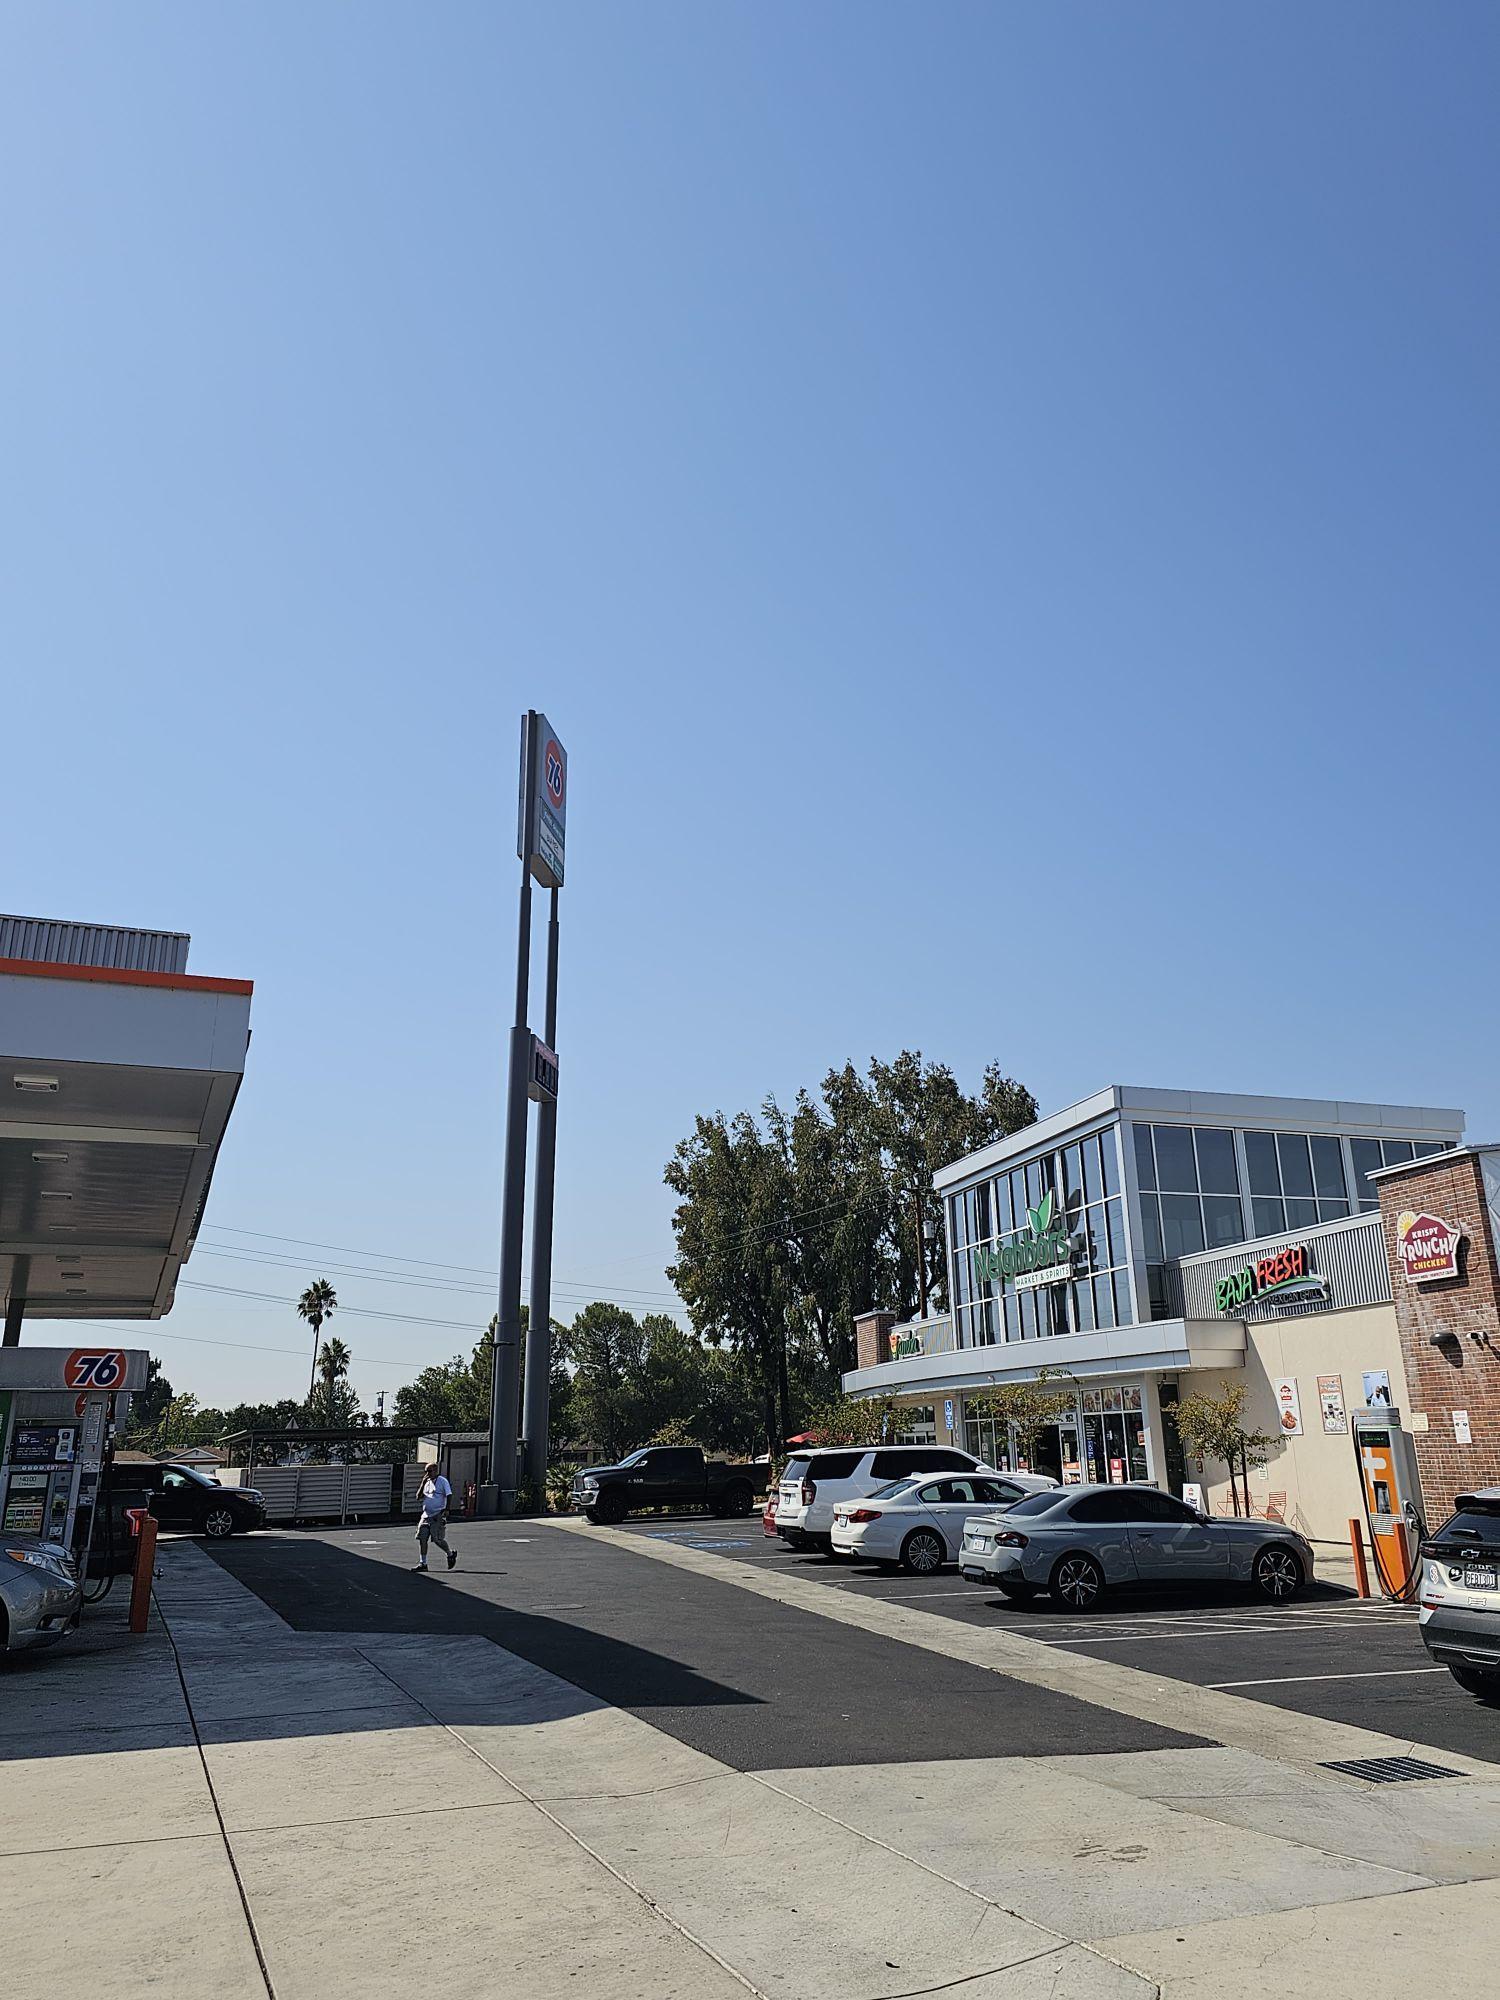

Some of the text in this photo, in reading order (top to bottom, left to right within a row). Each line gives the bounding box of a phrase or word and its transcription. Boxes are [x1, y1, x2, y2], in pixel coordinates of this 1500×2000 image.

[547, 753, 562, 797] 76
[1400, 1232, 1456, 1262] KRUNCHY
[1412, 1227, 1438, 1239] KRISPY
[974, 1229, 1071, 1284] Neighbors
[1413, 1257, 1447, 1270] CHICKEN
[1016, 1276, 1038, 1286] MARKET
[1046, 1266, 1070, 1279] SPIRITS
[1215, 1247, 1303, 1312] BAJA FRESH
[1268, 1288, 1321, 1305] MEXICAN GRILL
[72, 1353, 119, 1387] 76
